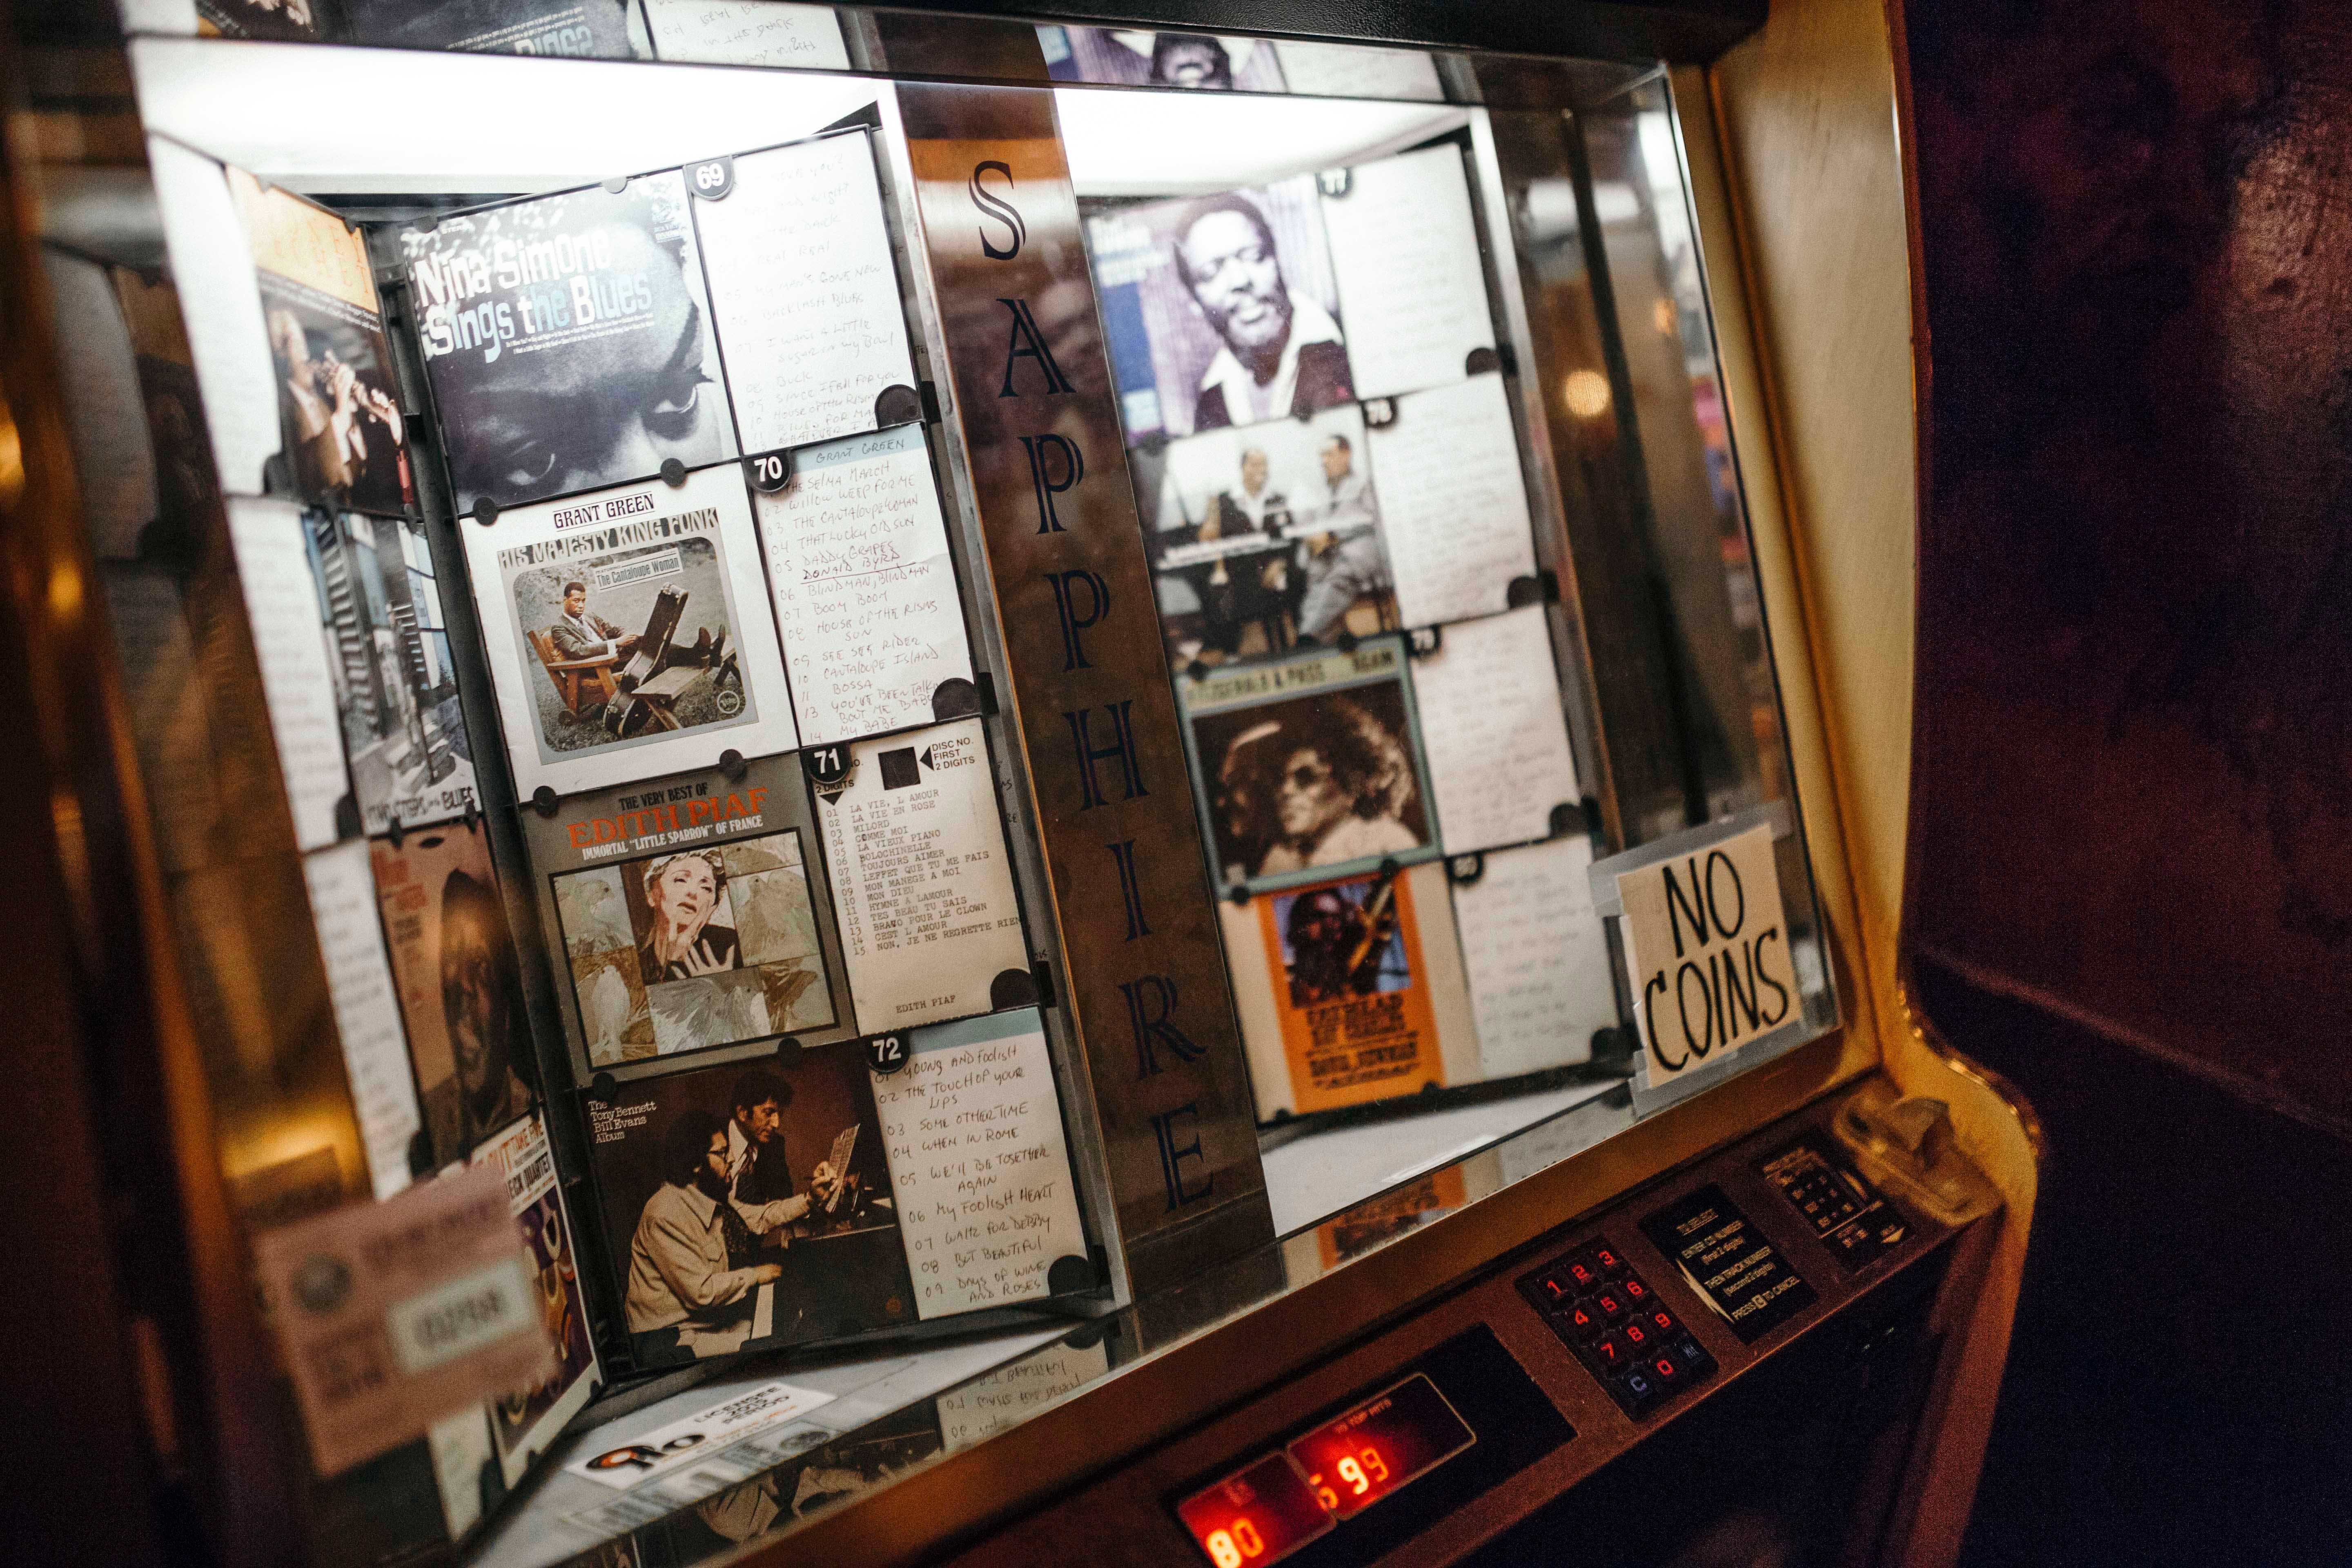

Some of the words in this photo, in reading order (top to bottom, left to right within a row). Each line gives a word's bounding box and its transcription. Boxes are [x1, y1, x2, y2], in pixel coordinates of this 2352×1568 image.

[696, 163, 724, 189] 69
[415, 251, 491, 307] Nina
[498, 229, 612, 289] Simone
[426, 299, 515, 363] Sings
[518, 284, 569, 334] the
[569, 274, 653, 327] Blues
[754, 456, 782, 482] 70
[554, 503, 599, 528] GRANT
[606, 494, 654, 518] GREEN
[499, 546, 530, 569] HIS
[532, 529, 612, 563] MAJESTY
[615, 519, 662, 547] KING
[666, 507, 719, 537] FUNK
[597, 575, 611, 587] The
[612, 564, 650, 583] Cantaloupe
[652, 558, 679, 572] Woman
[775, 561, 792, 573] 05
[783, 609, 801, 621] 07
[844, 628, 873, 641] SUN
[833, 678, 873, 695] BOSSA
[969, 160, 1214, 1213] SAPPHIRE
[932, 741, 954, 751] DISC
[956, 736, 974, 746] NO.
[934, 749, 961, 760] FIRST
[814, 748, 840, 774] 71
[943, 756, 976, 769] DIGITS
[619, 796, 639, 811] THE
[641, 791, 666, 806] VERY
[668, 786, 692, 801] BEST
[696, 783, 708, 796] OF
[826, 809, 838, 818] 01
[849, 804, 862, 813] LA
[909, 789, 940, 802] AMOUR
[566, 804, 682, 848] EDITH
[686, 787, 769, 826] PIAF
[828, 819, 840, 827] 02
[851, 814, 863, 823] LA
[870, 808, 892, 820] VIE
[893, 806, 905, 815] EN
[911, 800, 936, 811] ROSE
[582, 841, 629, 860] IMMORTAL
[716, 822, 727, 835] OF
[730, 815, 763, 832] FRANCE
[830, 829, 843, 838] 03
[853, 819, 890, 833] MILORD
[832, 838, 844, 847] 04
[855, 830, 886, 843] COMME
[891, 826, 909, 836] MOI
[833, 848, 846, 857] 05
[857, 843, 869, 852] LA
[875, 836, 904, 849] VIEUX
[911, 829, 942, 842] PIANO
[837, 868, 850, 876] 07
[861, 856, 909, 872] TOUJOURS
[914, 849, 945, 862] AIMER
[840, 878, 852, 886] 08
[904, 863, 923, 874] QUE
[928, 860, 940, 869] TU
[946, 857, 959, 866] ME
[964, 851, 989, 862] FAIS
[841, 888, 854, 896] 09
[864, 881, 884, 892] MON
[888, 874, 925, 888] MANEGE
[942, 867, 961, 877] MOI
[845, 907, 858, 916] 11
[868, 899, 900, 912] HYMNE
[917, 888, 953, 902] LAMOUR
[847, 917, 860, 926] 12
[870, 911, 889, 922] TES
[895, 905, 919, 917] BEAU
[924, 902, 937, 911] TU
[942, 896, 967, 908] SAIS
[1663, 851, 1744, 958] NO
[853, 947, 866, 956] 15
[906, 936, 920, 946] JE
[924, 932, 938, 942] NE
[942, 922, 993, 938] REGRETTE
[997, 916, 1021, 928] RIEN
[895, 1000, 927, 1013] EDITH
[931, 994, 957, 1007] PIAF
[1645, 928, 1788, 1072] COINS
[872, 1037, 901, 1062] 72
[588, 1100, 608, 1111] The
[590, 1110, 614, 1121] Tony
[615, 1101, 657, 1117] Bennett
[593, 1120, 613, 1133] Bill
[613, 1116, 647, 1129] Evans
[596, 1131, 625, 1143] Album
[887, 1123, 905, 1138] 03
[919, 1115, 949, 1132] SOME
[893, 1145, 911, 1160] 04
[922, 1136, 957, 1152] WHEN
[967, 1134, 980, 1144] IN
[984, 1123, 1019, 1142] ROME
[1547, 1281, 1561, 1293] 1
[1572, 1265, 1589, 1280] 2
[1599, 1251, 1614, 1265] 3
[1575, 1310, 1588, 1325] 4
[1600, 1297, 1617, 1312] 5
[1627, 1281, 1643, 1296] 6
[1600, 1343, 1614, 1359] 7
[1627, 1326, 1644, 1341] 8
[1655, 1313, 1671, 1328] 9
[1630, 1376, 1647, 1392] C
[1657, 1360, 1673, 1376] 0
[1206, 1517, 1265, 1568] 80
